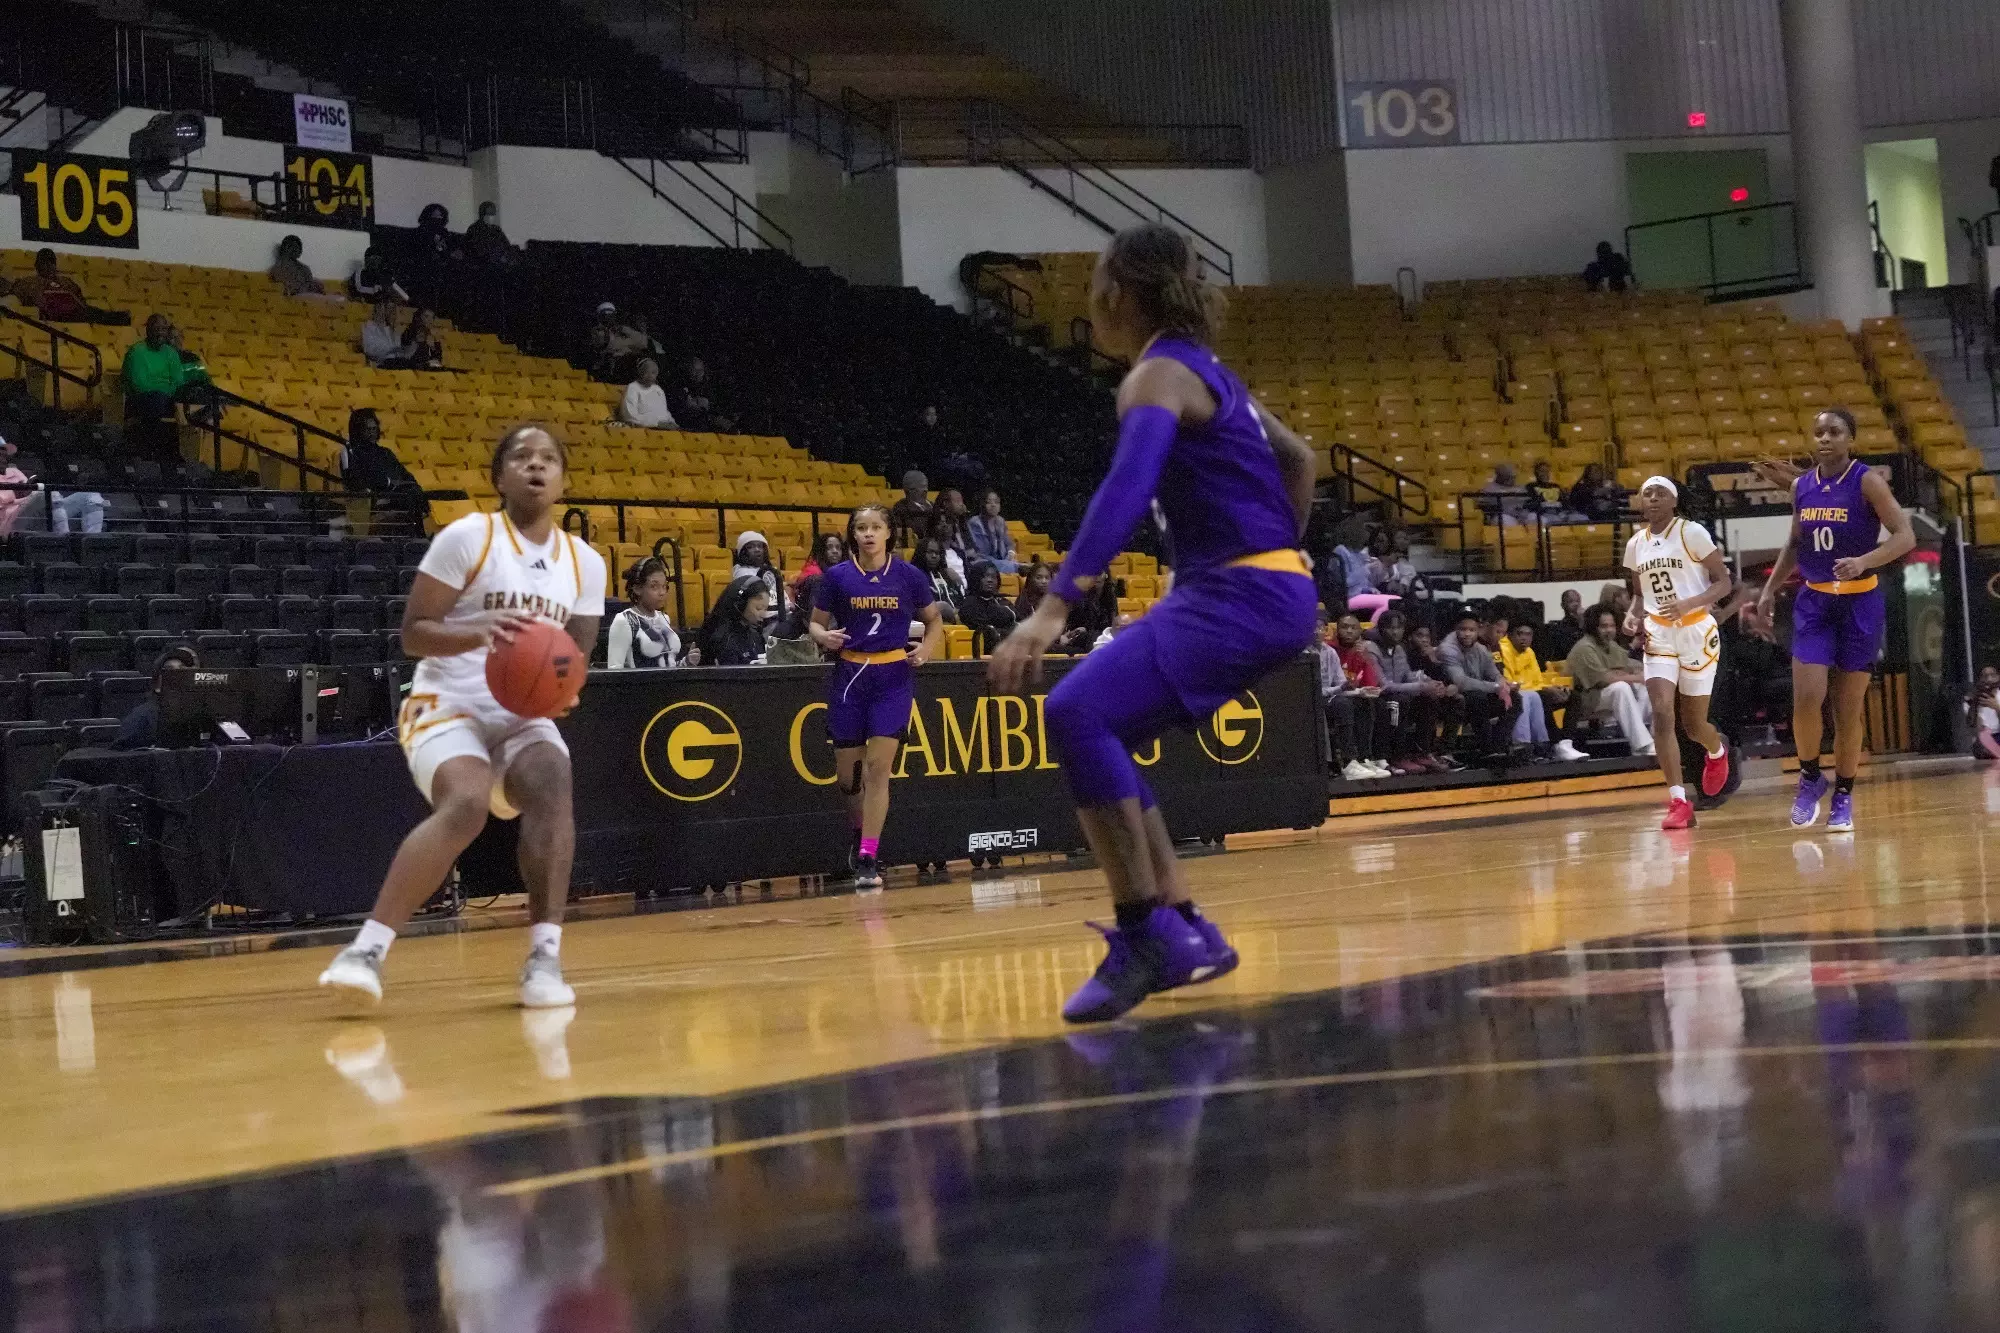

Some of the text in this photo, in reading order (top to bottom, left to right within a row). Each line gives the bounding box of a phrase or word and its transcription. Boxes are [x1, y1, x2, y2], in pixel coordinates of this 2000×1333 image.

[310, 103, 347, 127] PHSC
[1352, 87, 1455, 137] 103
[287, 156, 371, 217] 104
[23, 162, 133, 237] 105
[1800, 507, 1848, 522] PANTHERS
[1812, 526, 1834, 552] 10
[1637, 558, 1683, 573] GRAMBLING
[1649, 570, 1673, 593] 23
[850, 596, 899, 610] PANTHERS
[867, 612, 882, 636] 2
